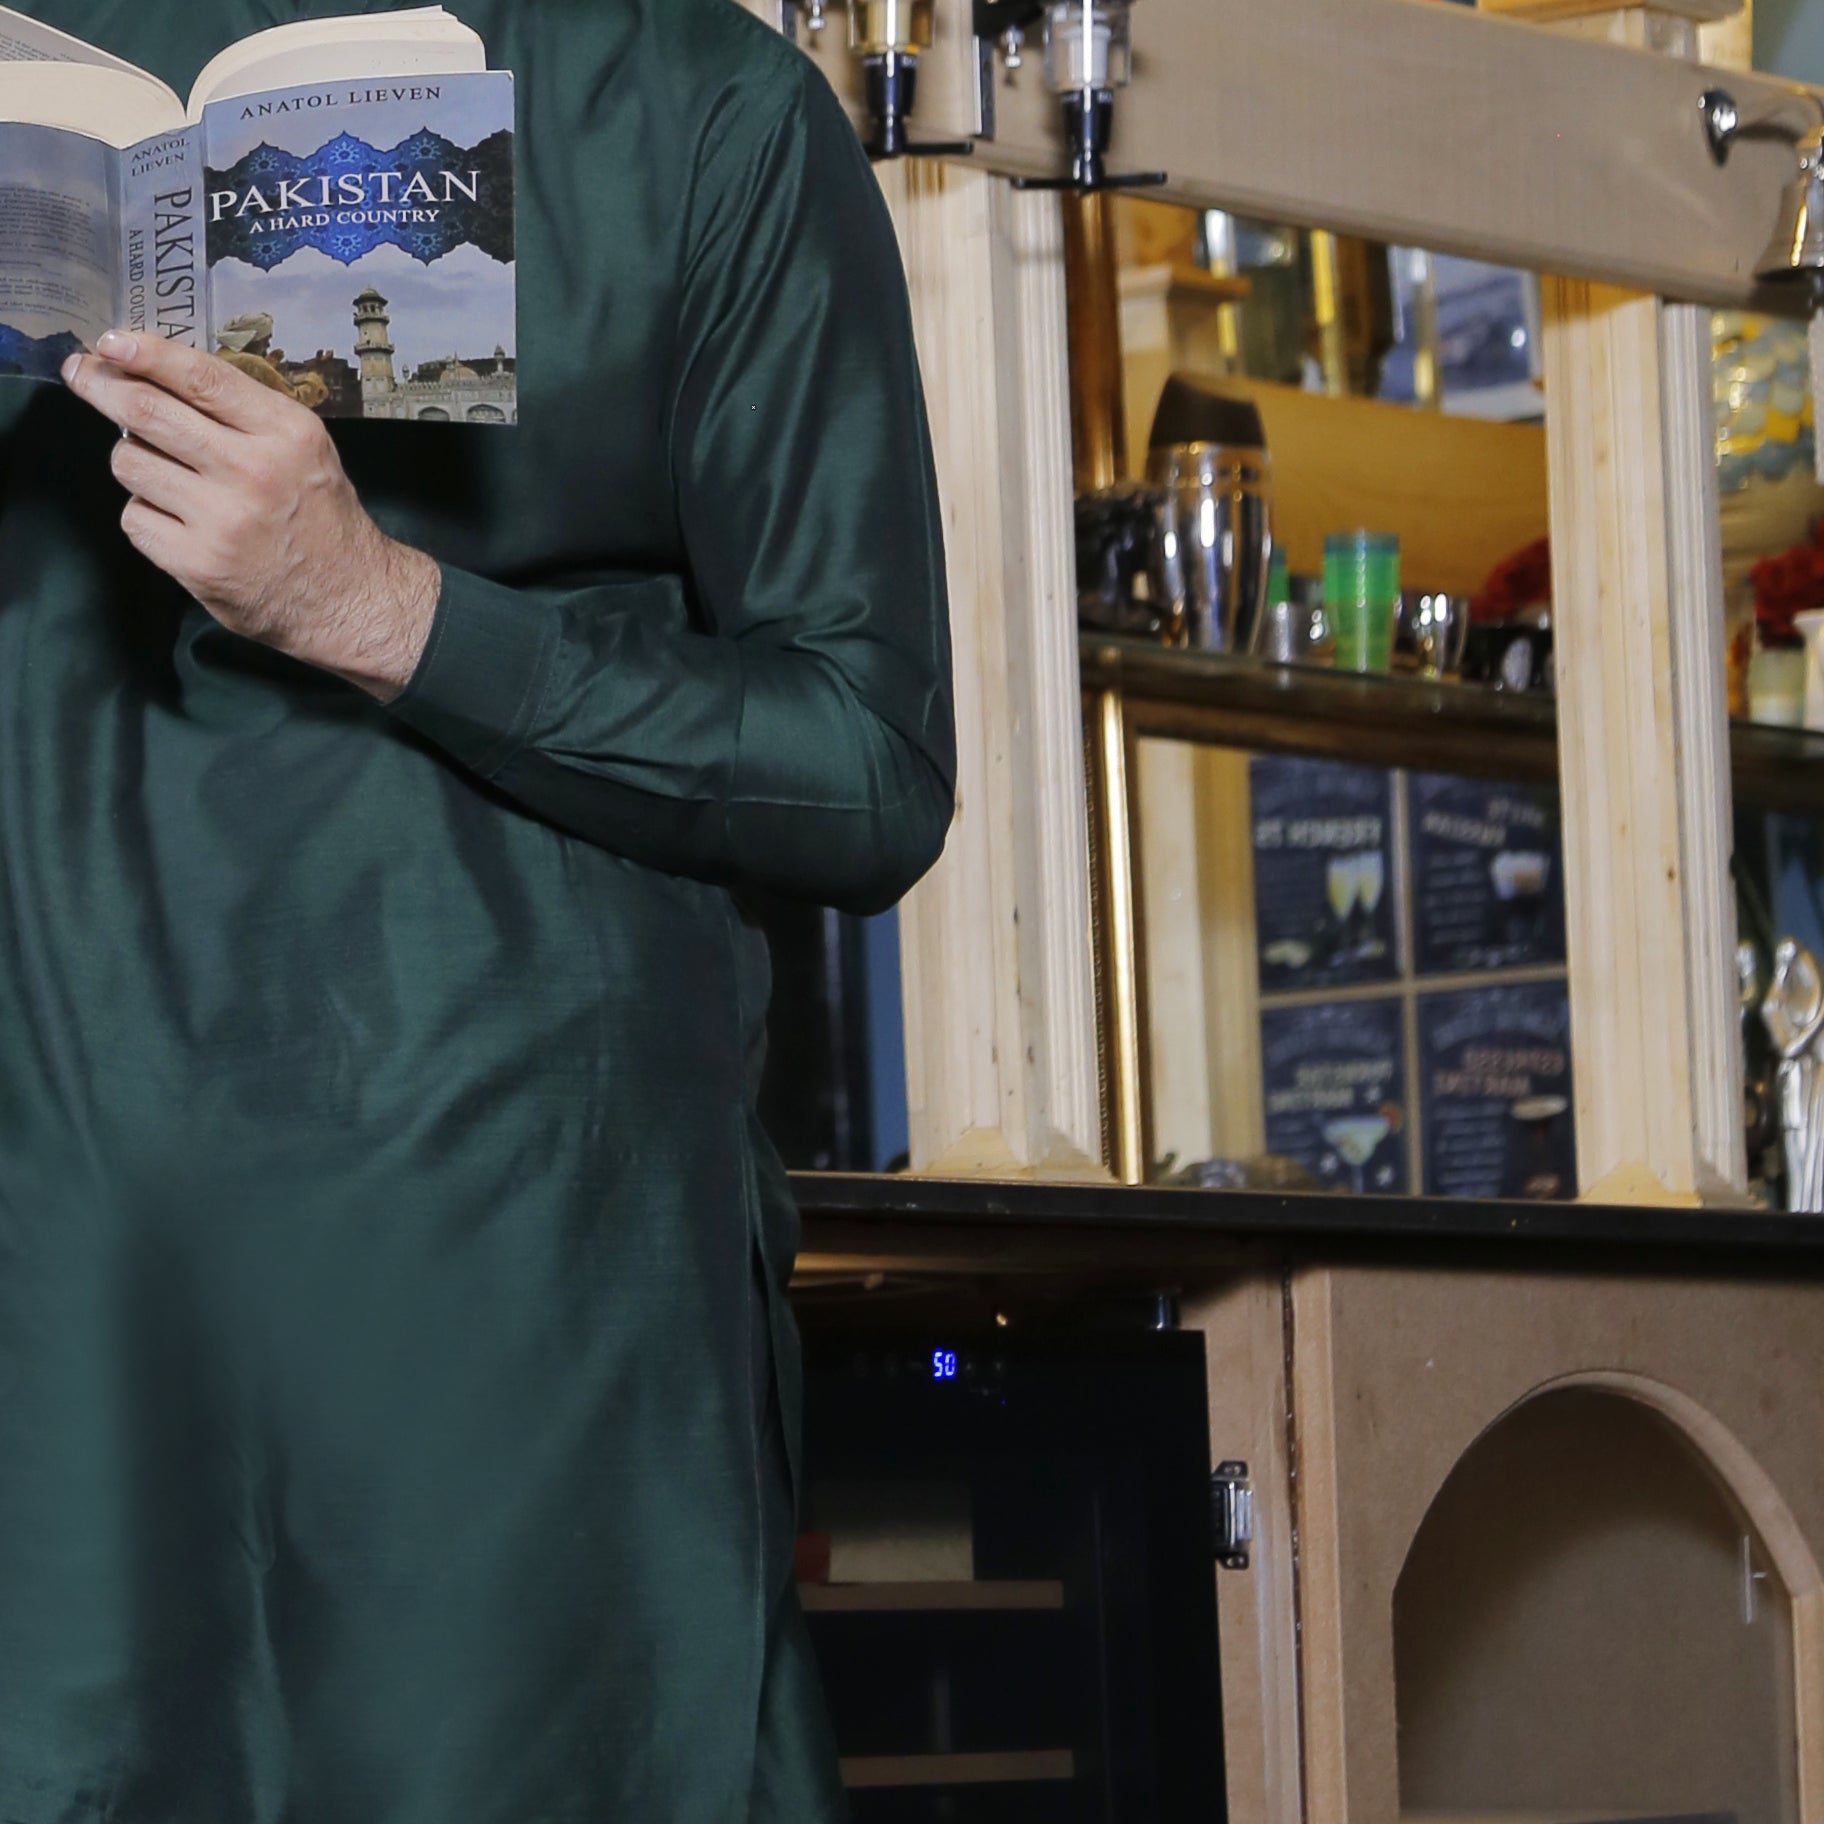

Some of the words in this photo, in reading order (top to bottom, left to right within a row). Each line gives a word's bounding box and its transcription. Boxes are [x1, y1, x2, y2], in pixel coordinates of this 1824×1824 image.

[240, 93, 339, 120] ANATOL
[349, 87, 441, 104] LIEVEN
[131, 137, 191, 163] ANATOL
[132, 152, 186, 177] LIEVEN
[209, 170, 481, 223] PAKISTAN
[129, 229, 143, 240] A
[249, 220, 264, 234] A
[269, 211, 330, 231] HARD
[336, 209, 440, 225] COUNTRY
[129, 244, 144, 282] HARD
[154, 186, 195, 349] PAKISTA
[129, 284, 145, 333] COUNT
[933, 1350, 956, 1378] 50
